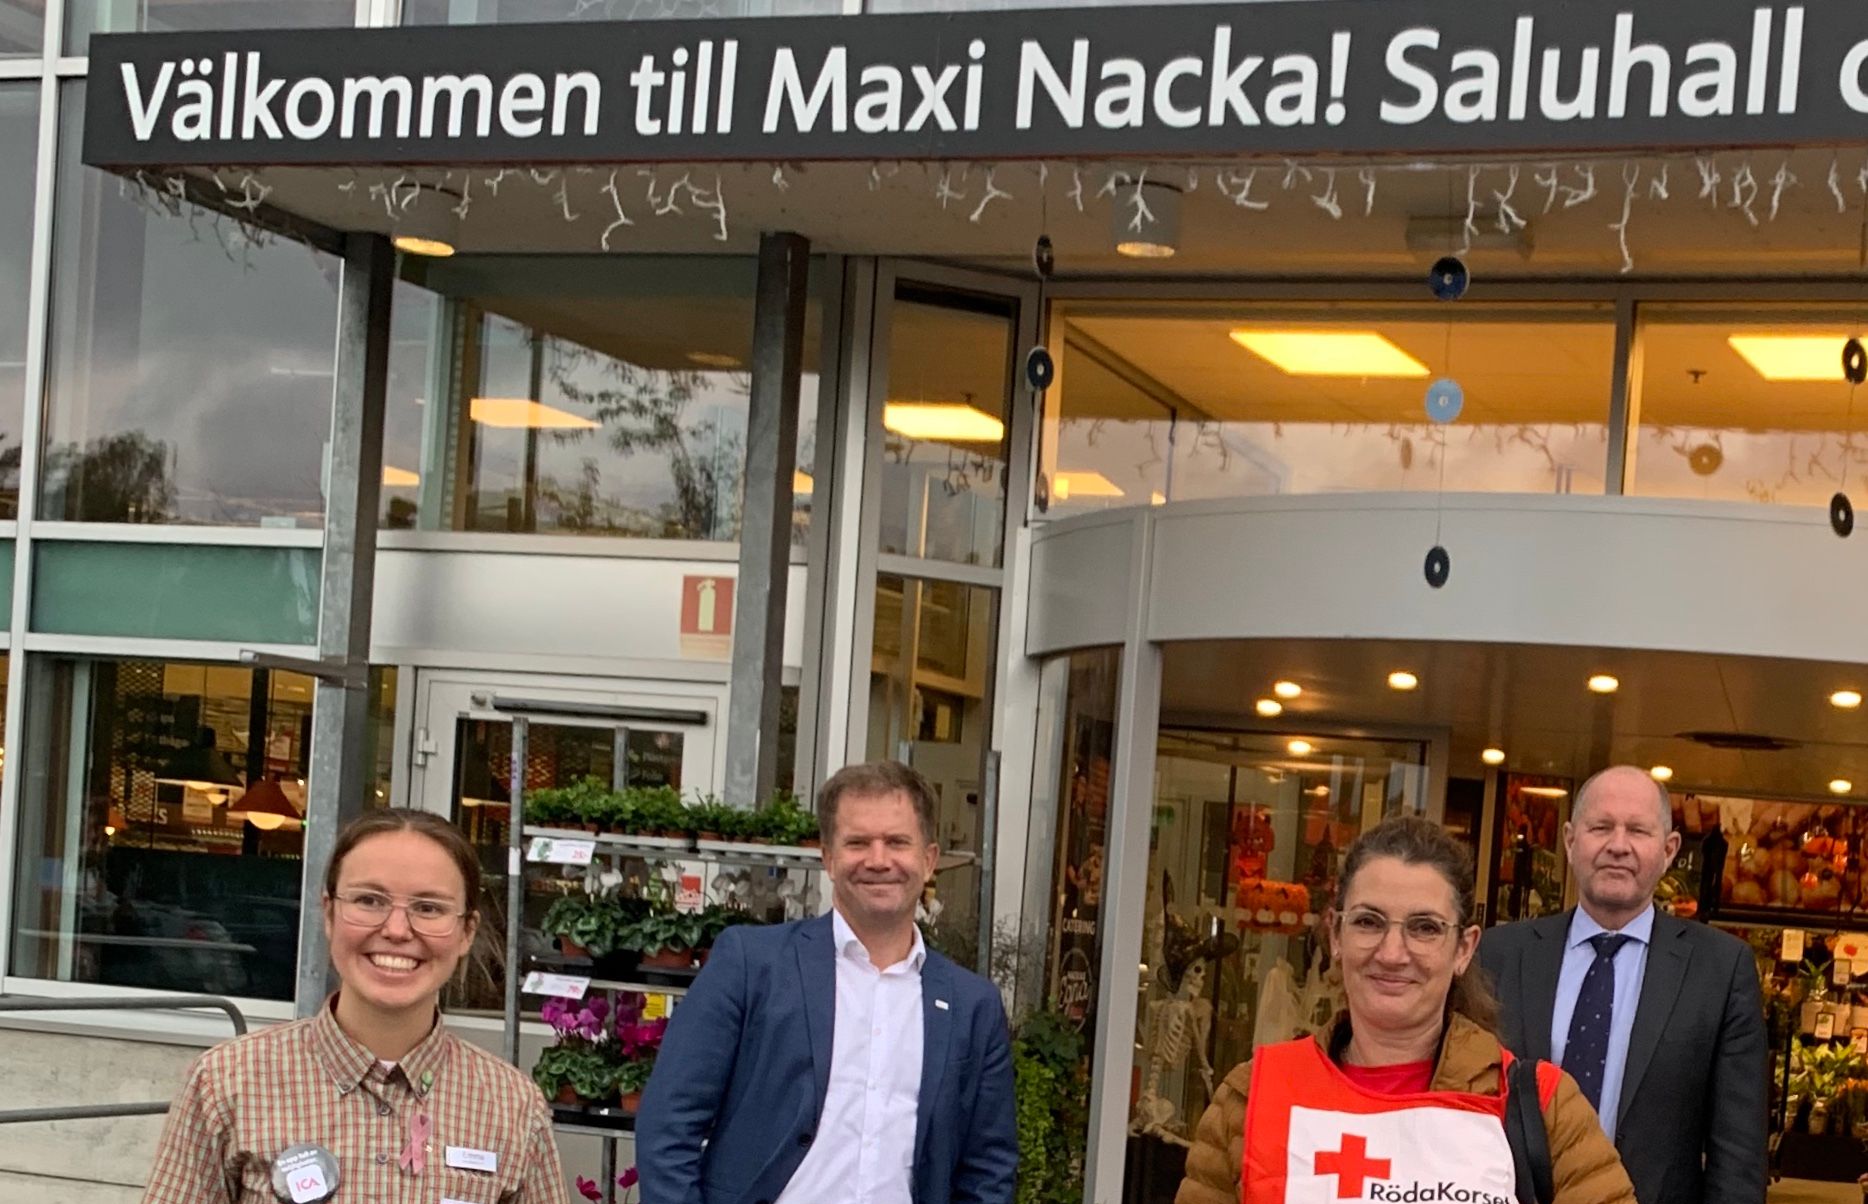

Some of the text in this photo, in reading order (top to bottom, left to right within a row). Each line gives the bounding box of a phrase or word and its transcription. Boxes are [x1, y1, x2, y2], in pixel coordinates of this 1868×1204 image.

[121, 52, 600, 140] Välkommen
[631, 41, 737, 135] till
[763, 40, 985, 132] Maxi
[1016, 26, 1350, 128] Nacka!
[1381, 7, 1803, 123] Saluhall
[296, 1177, 321, 1192] ICA
